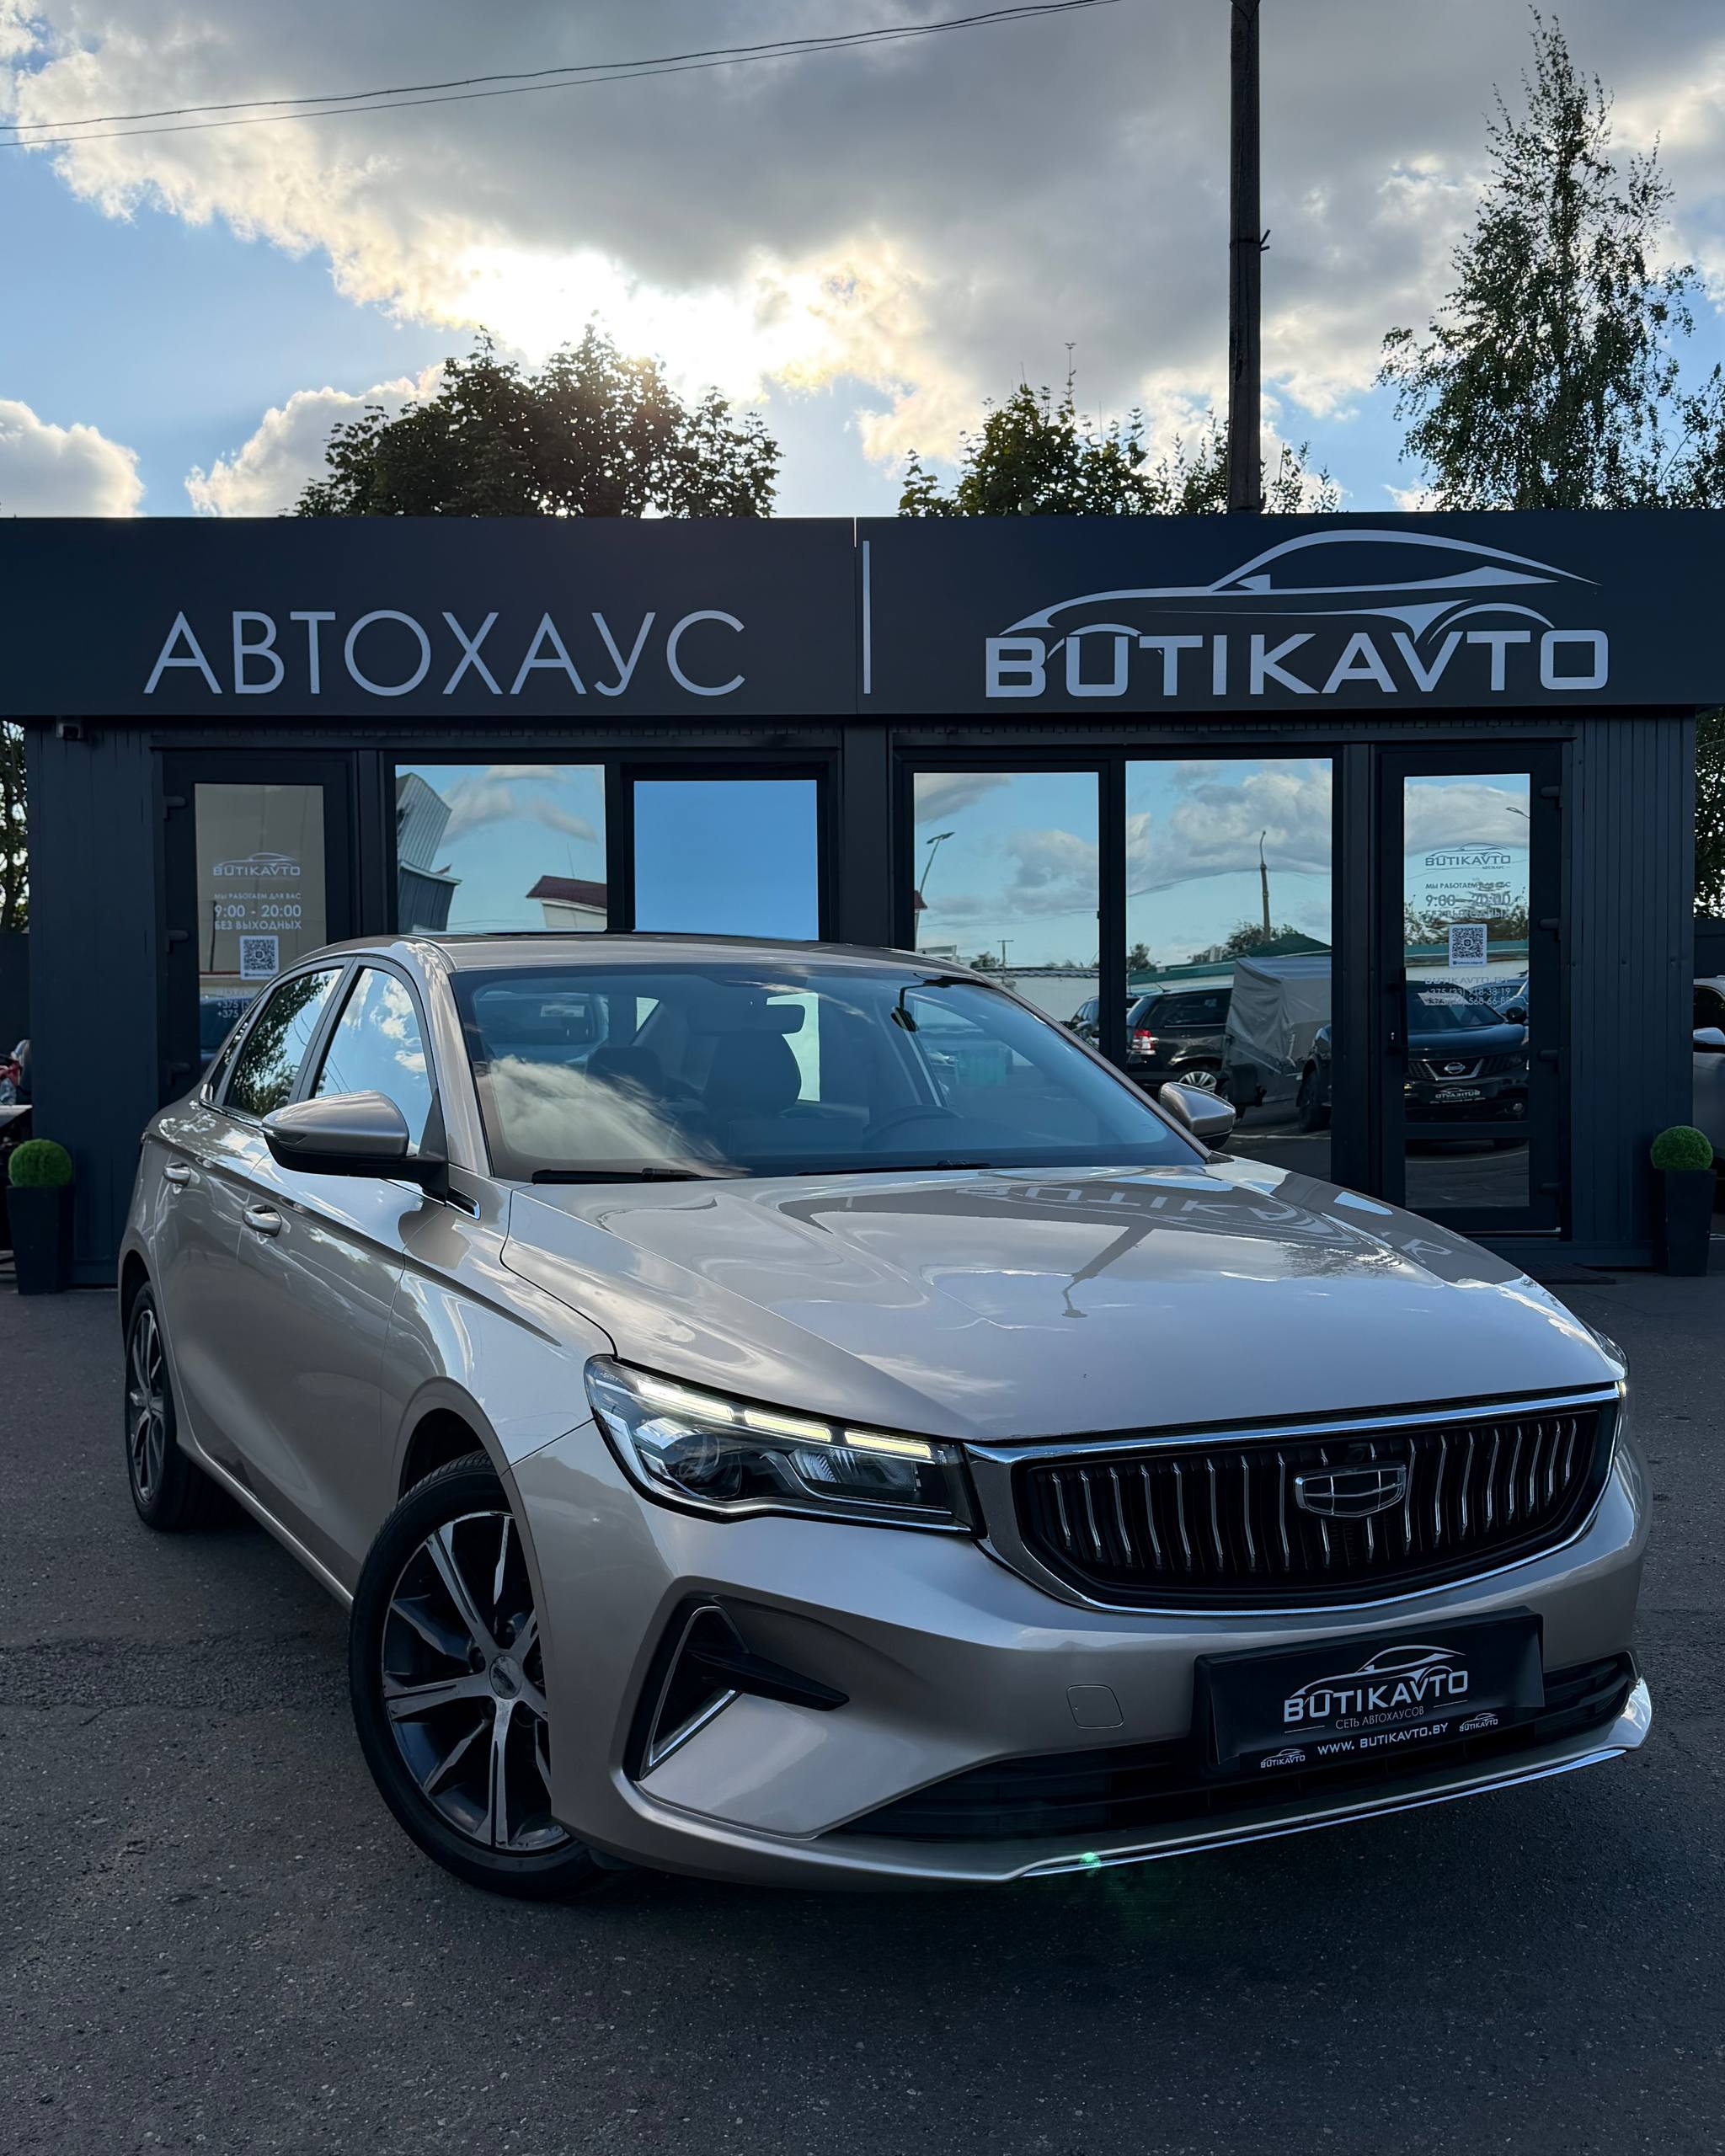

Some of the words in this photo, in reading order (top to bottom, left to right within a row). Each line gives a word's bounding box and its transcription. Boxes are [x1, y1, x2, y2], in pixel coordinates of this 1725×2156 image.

[143, 610, 746, 696] АВТОХАУС
[985, 627, 1610, 698] BUTIKAVTO
[1425, 856, 1511, 866] BUTIKAVTO
[213, 865, 301, 876] BUTIKAVTO
[1425, 894, 1455, 907] 9:00
[215, 905, 246, 917] 9:00
[261, 905, 302, 917] 20:00
[215, 921, 232, 930] БЕЗ
[236, 920, 302, 930] ВЫХОДНЫХ
[1284, 1670, 1468, 1722] BUTIKAVTO
[1335, 1718, 1360, 1730] СЕТЬ
[1362, 1705, 1424, 1726] АВТОХАУСОВ
[1459, 1718, 1498, 1732] BUTIKAVTO
[1360, 1722, 1449, 1748] BUTIKAVTO.BY
[1260, 1754, 1306, 1769] BUTIKAVTO
